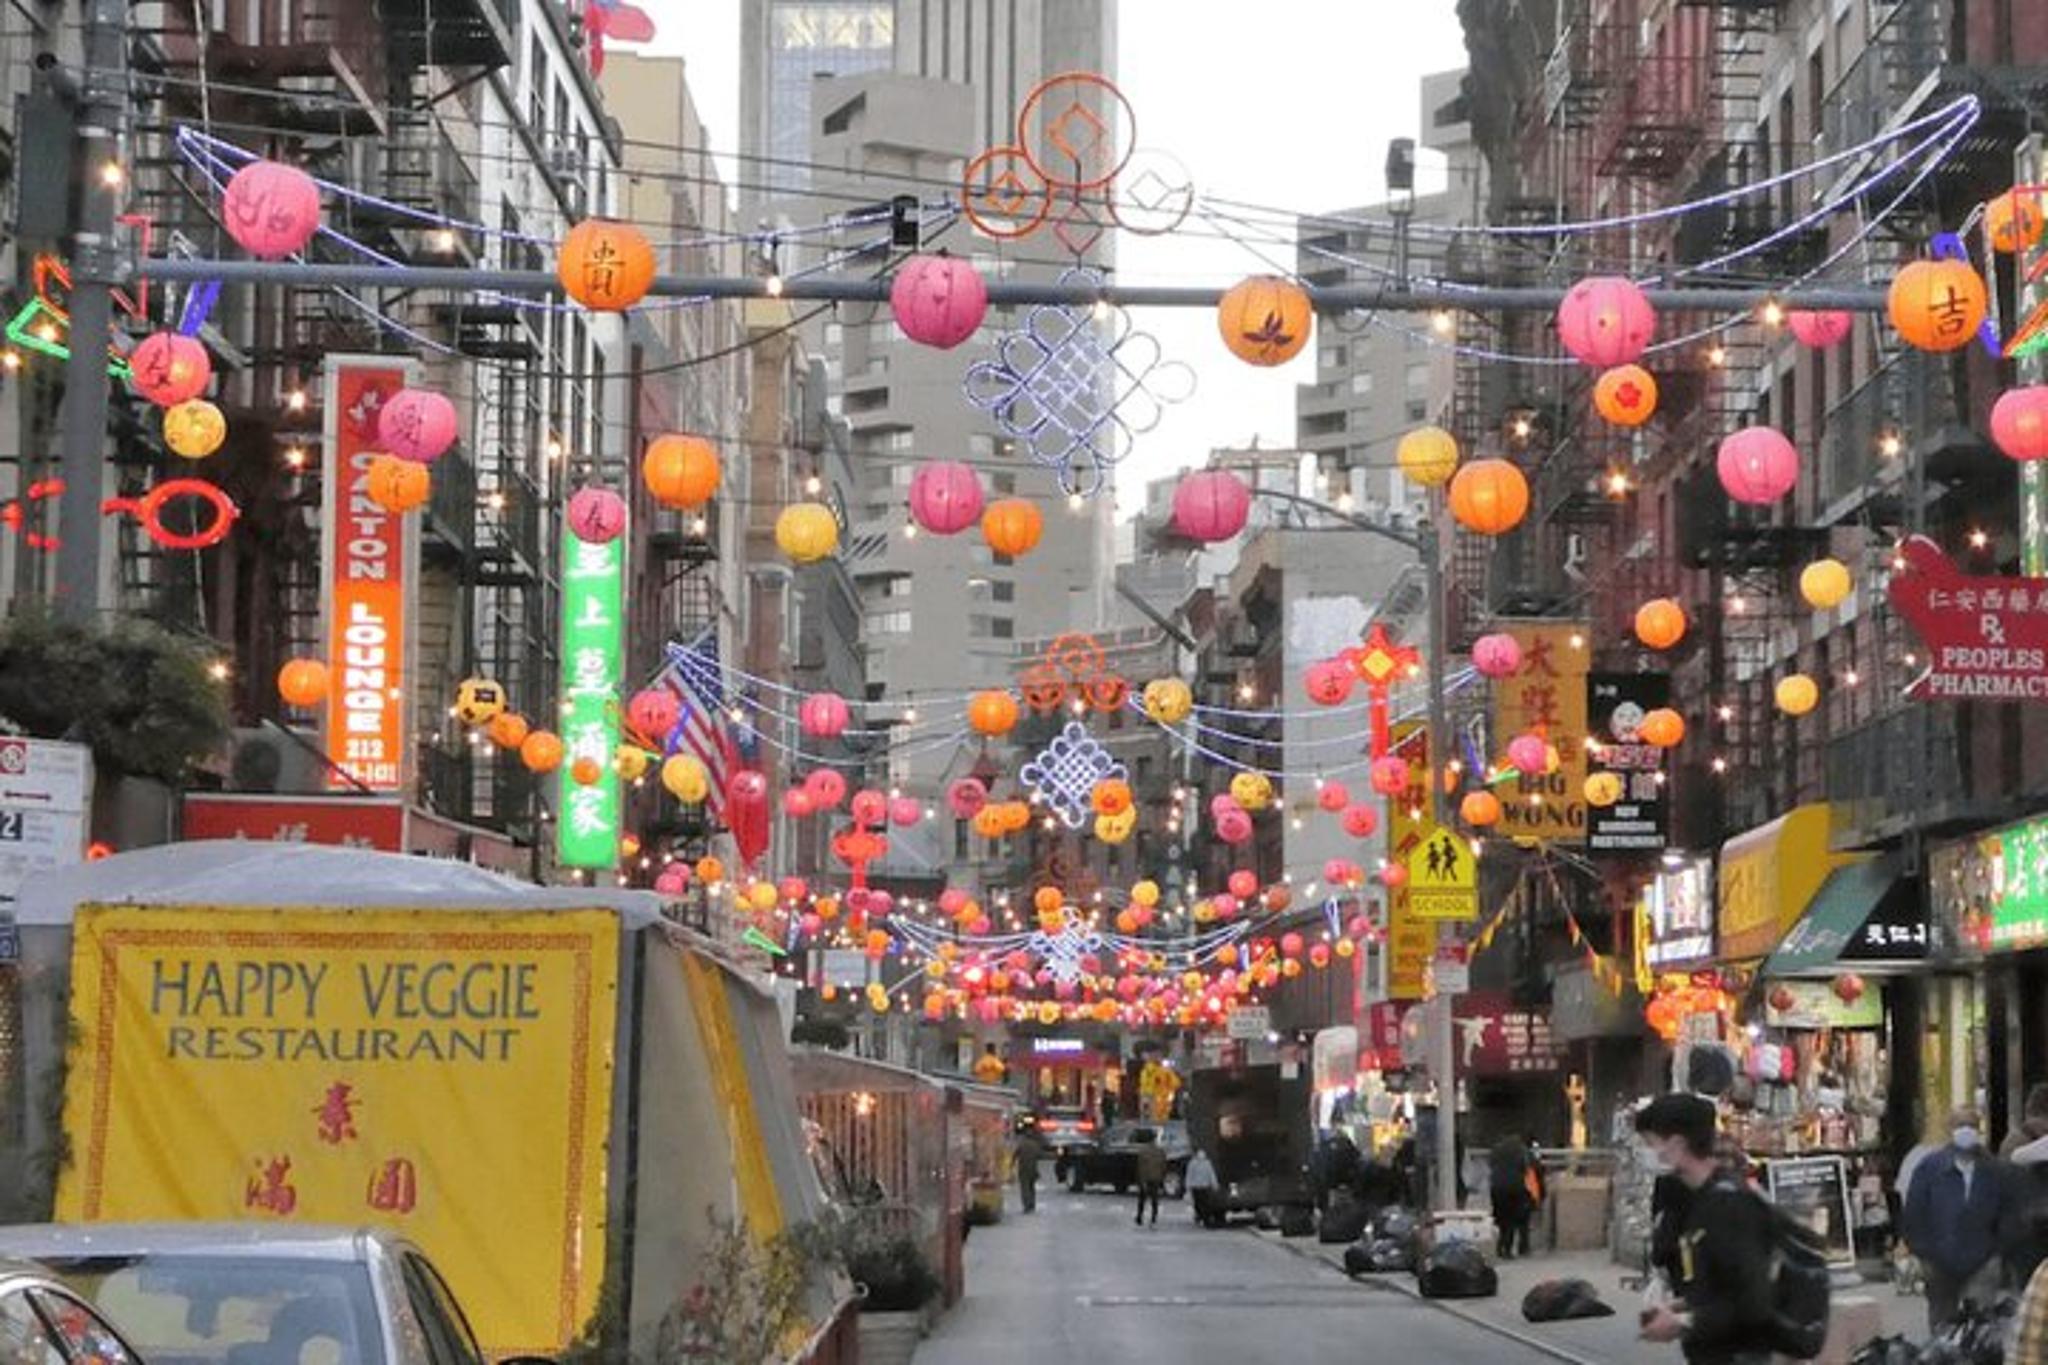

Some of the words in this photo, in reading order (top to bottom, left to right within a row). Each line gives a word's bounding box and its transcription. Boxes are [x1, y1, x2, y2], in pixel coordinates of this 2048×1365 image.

[345, 603, 387, 732] LOUNGE
[1942, 648, 2045, 669] PEOPLES
[346, 738, 384, 759] 212
[1502, 801, 1583, 829] WONG
[1414, 897, 1470, 911] SCHOOL
[151, 959, 328, 1018] HAPPY
[360, 961, 540, 1021] VEGGIE
[166, 1027, 520, 1062] RESTAURANT
